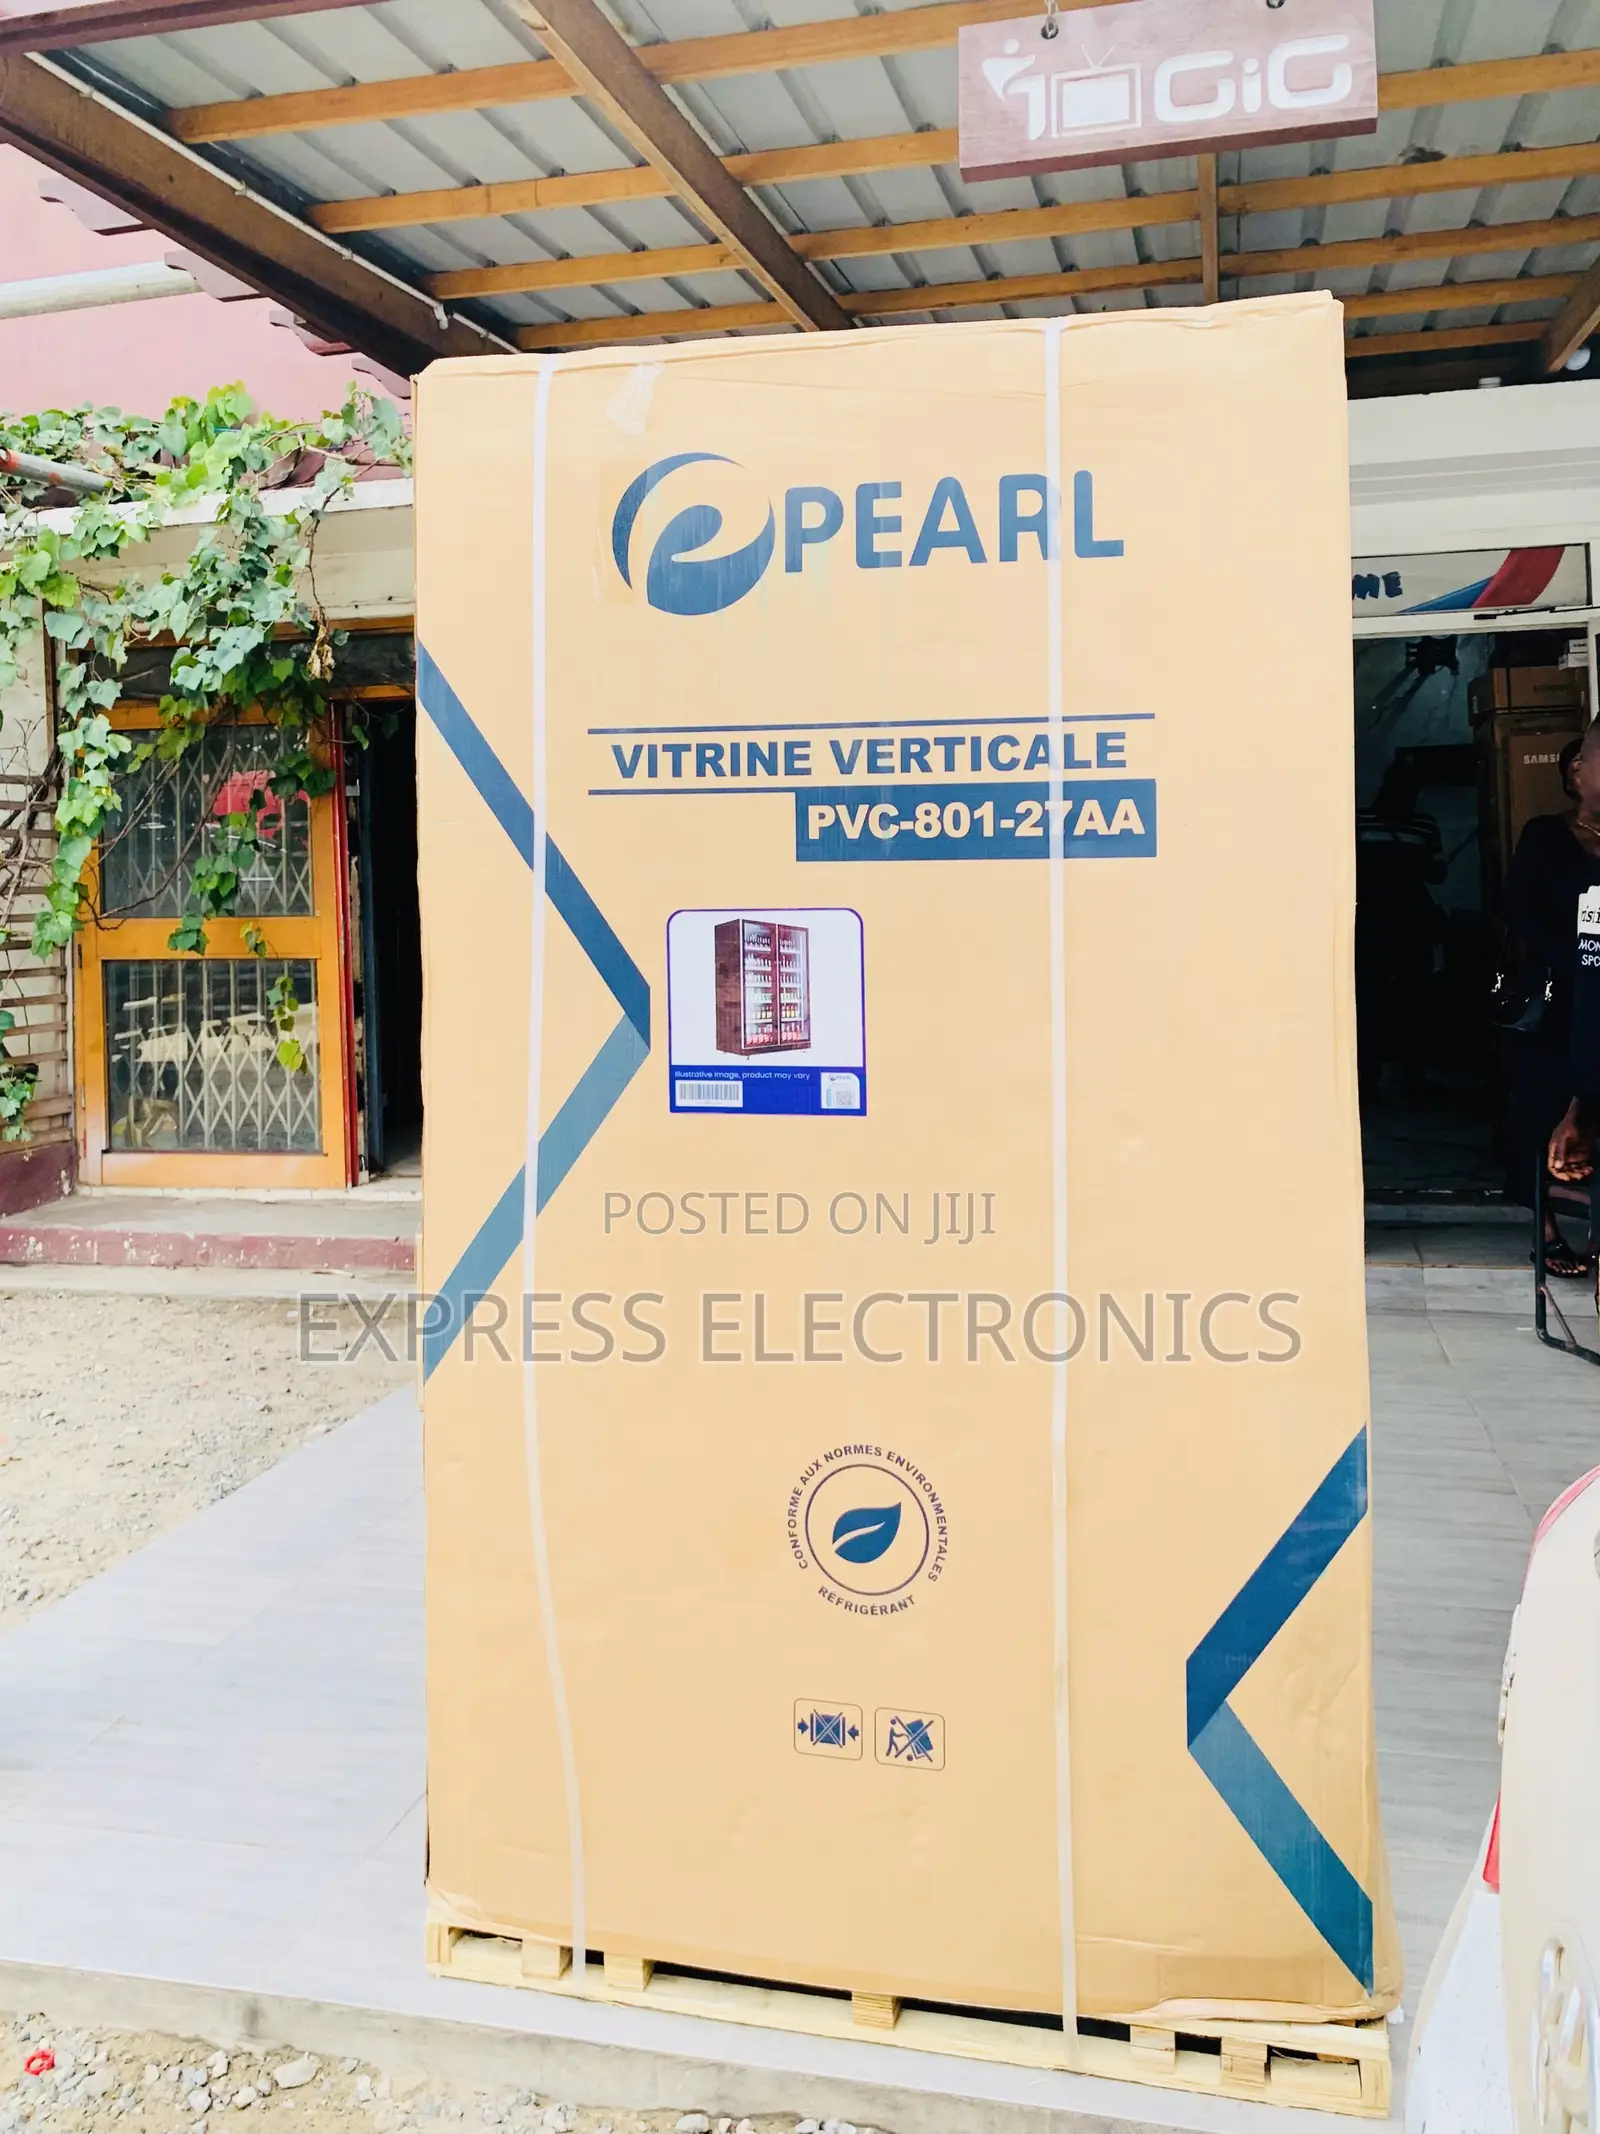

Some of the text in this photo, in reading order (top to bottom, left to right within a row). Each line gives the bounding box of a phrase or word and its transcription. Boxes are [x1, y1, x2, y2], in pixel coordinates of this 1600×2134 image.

[611, 731, 1127, 779] VITRINE VERTICALE
[1523, 753, 1560, 765] SAMS
[807, 798, 1146, 841] PVC-801-27AA
[742, 1072, 773, 1080] product
[793, 1073, 811, 1081] vary
[787, 1444, 948, 1582] CONFORME AUX NORMES ENVIRONMENTALES
